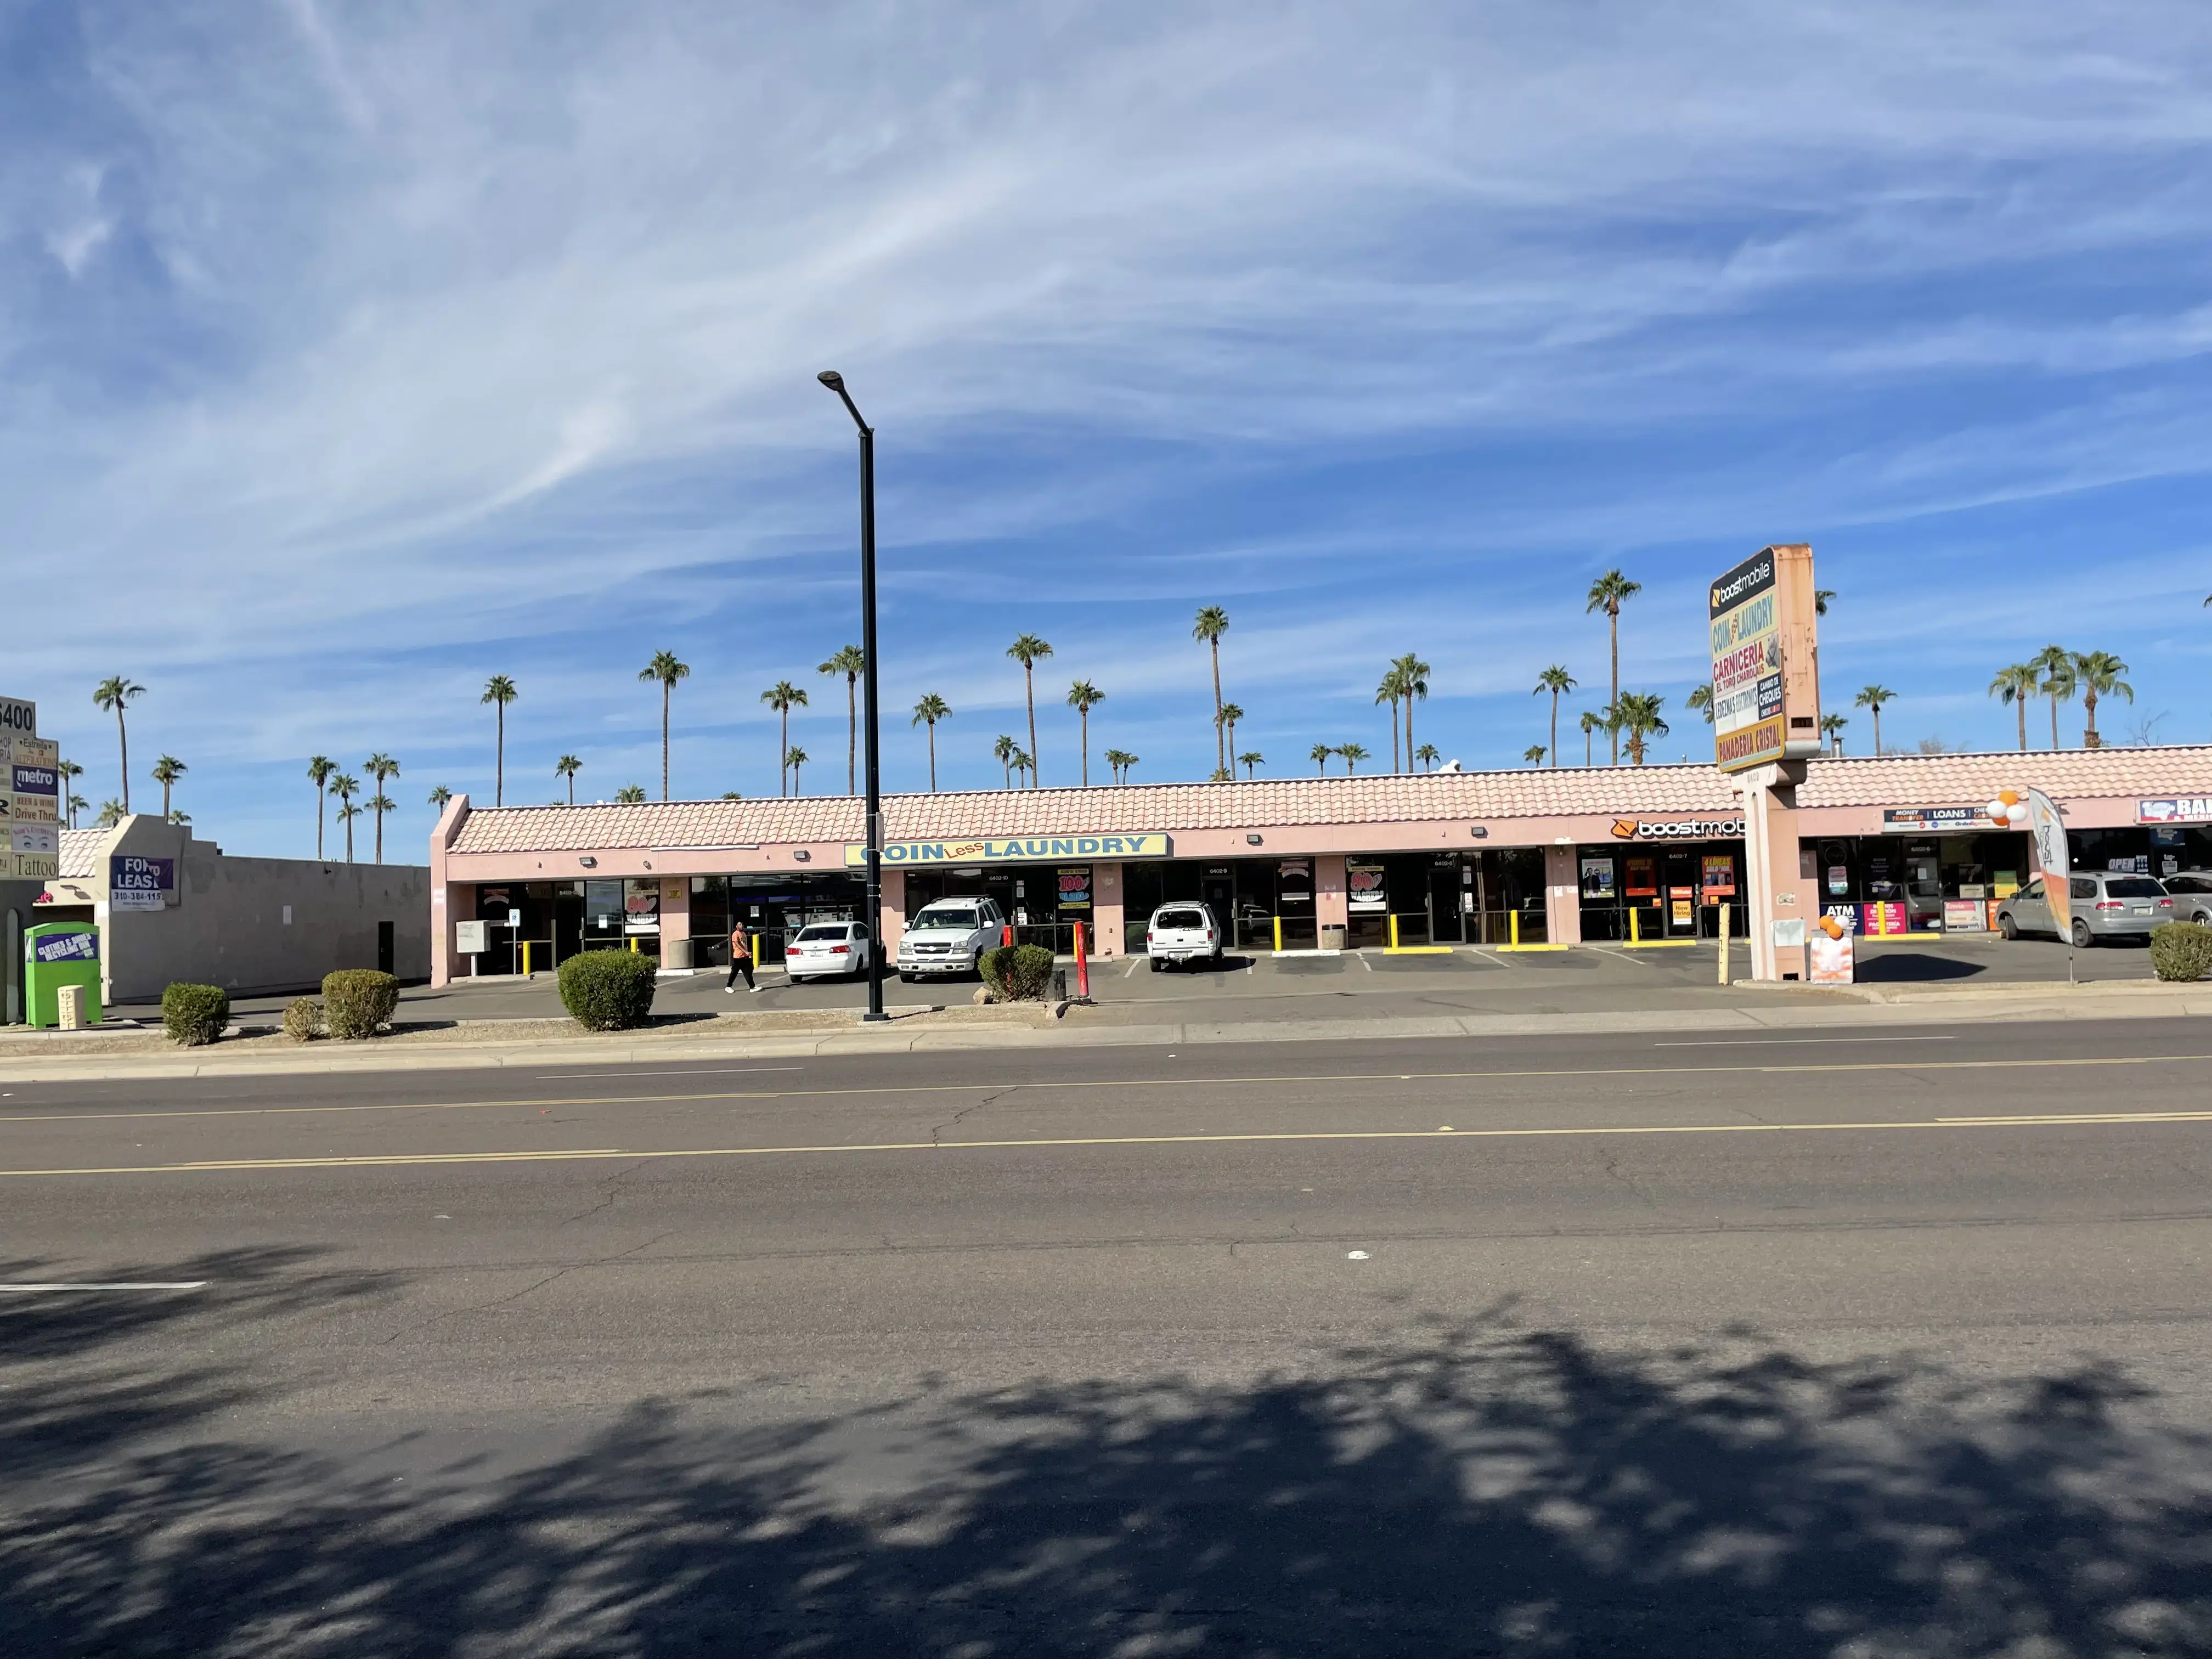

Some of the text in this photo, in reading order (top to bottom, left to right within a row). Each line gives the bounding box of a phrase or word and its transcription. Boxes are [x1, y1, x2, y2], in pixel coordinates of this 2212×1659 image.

[1720, 562, 1770, 603] boostmobile
[1713, 618, 1731, 653] COIN
[1737, 594, 1773, 641] LAUNDRY
[1713, 641, 1764, 682] CARNICERIA
[1717, 682, 1723, 692] EL
[1723, 676, 1736, 690] TORO
[1759, 686, 1781, 706] CHEQUES
[1719, 723, 1781, 763] PANADERIA CRISTAL
[16, 769, 53, 787] metro
[17, 797, 55, 808] BEER & WINE
[15, 808, 57, 821] Drive Thru
[1933, 810, 1966, 819] LOANS
[1638, 817, 1746, 837] boostmob
[944, 842, 985, 859] Less
[984, 837, 1148, 857] LAUNDRY
[2043, 825, 2054, 866] boost
[15, 854, 57, 877] Tattoo
[2108, 858, 2135, 872] OPEN
[1826, 905, 1855, 916] ATM
